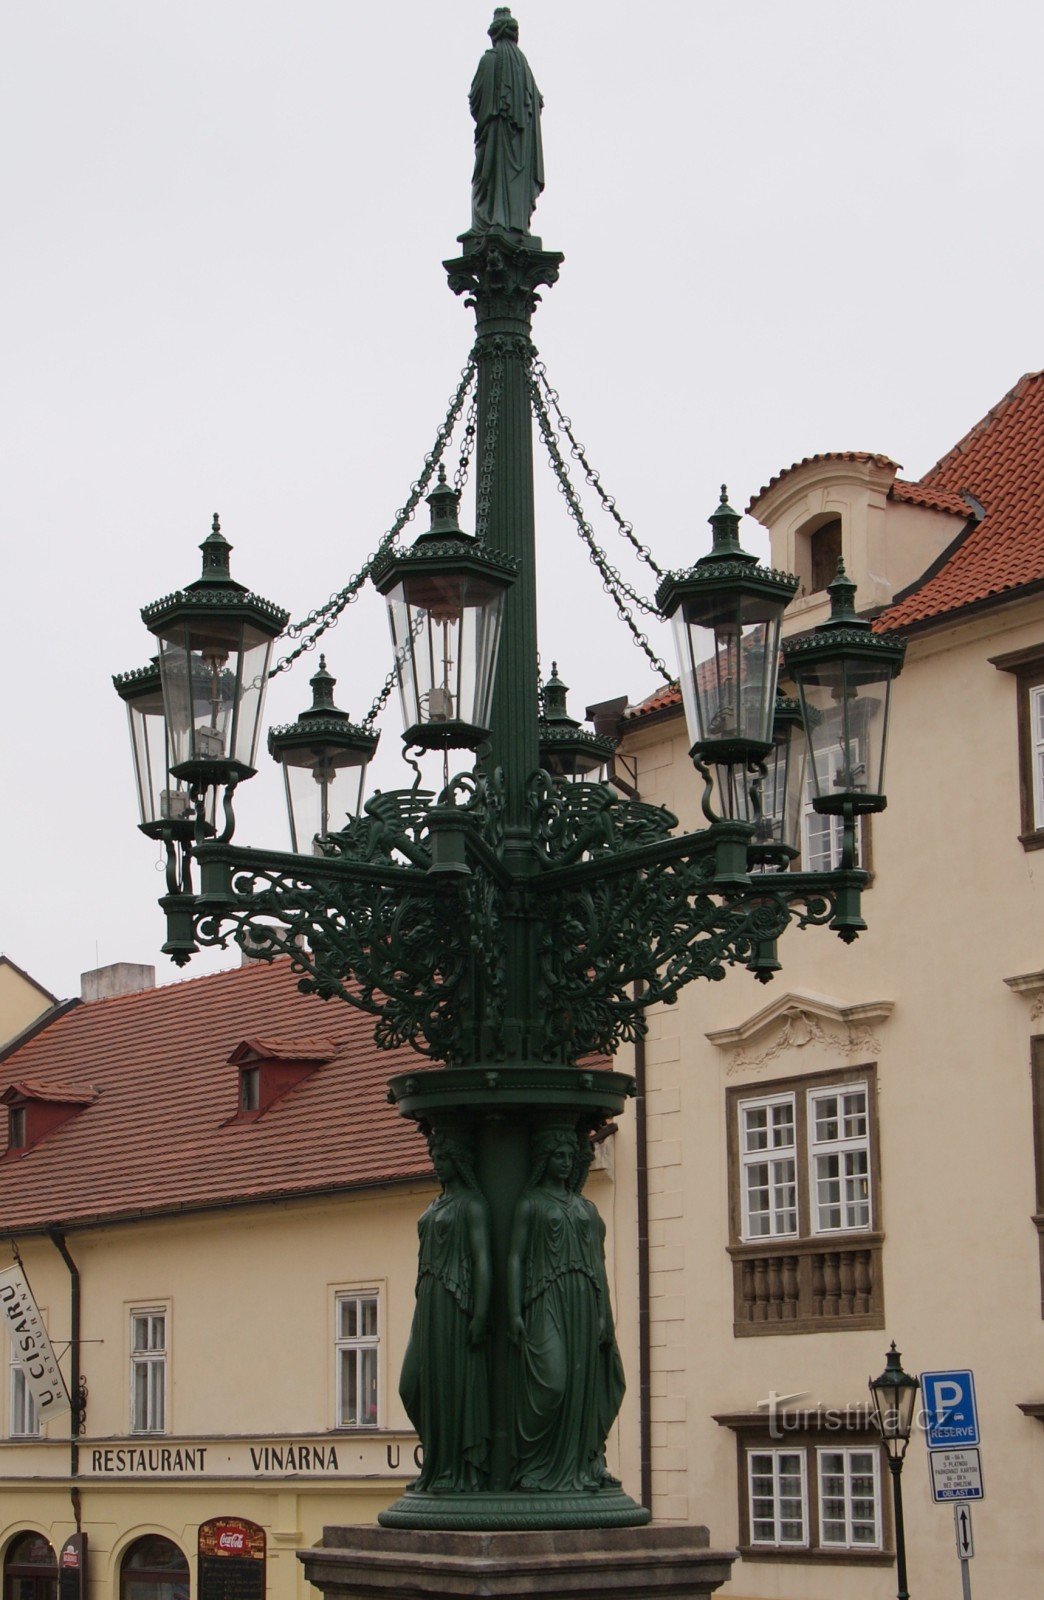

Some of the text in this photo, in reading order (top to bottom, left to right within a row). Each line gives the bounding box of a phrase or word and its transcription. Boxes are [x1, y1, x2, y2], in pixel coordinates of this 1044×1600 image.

[15, 1282, 63, 1399] RESTAURANT
[39, 1390, 54, 1407] U
[933, 1381, 963, 1424] P
[92, 1448, 207, 1471] RESTAURANT
[250, 1443, 339, 1471] VINÁRNA
[387, 1444, 400, 1469] U
[943, 1489, 968, 1497] OBLAST
